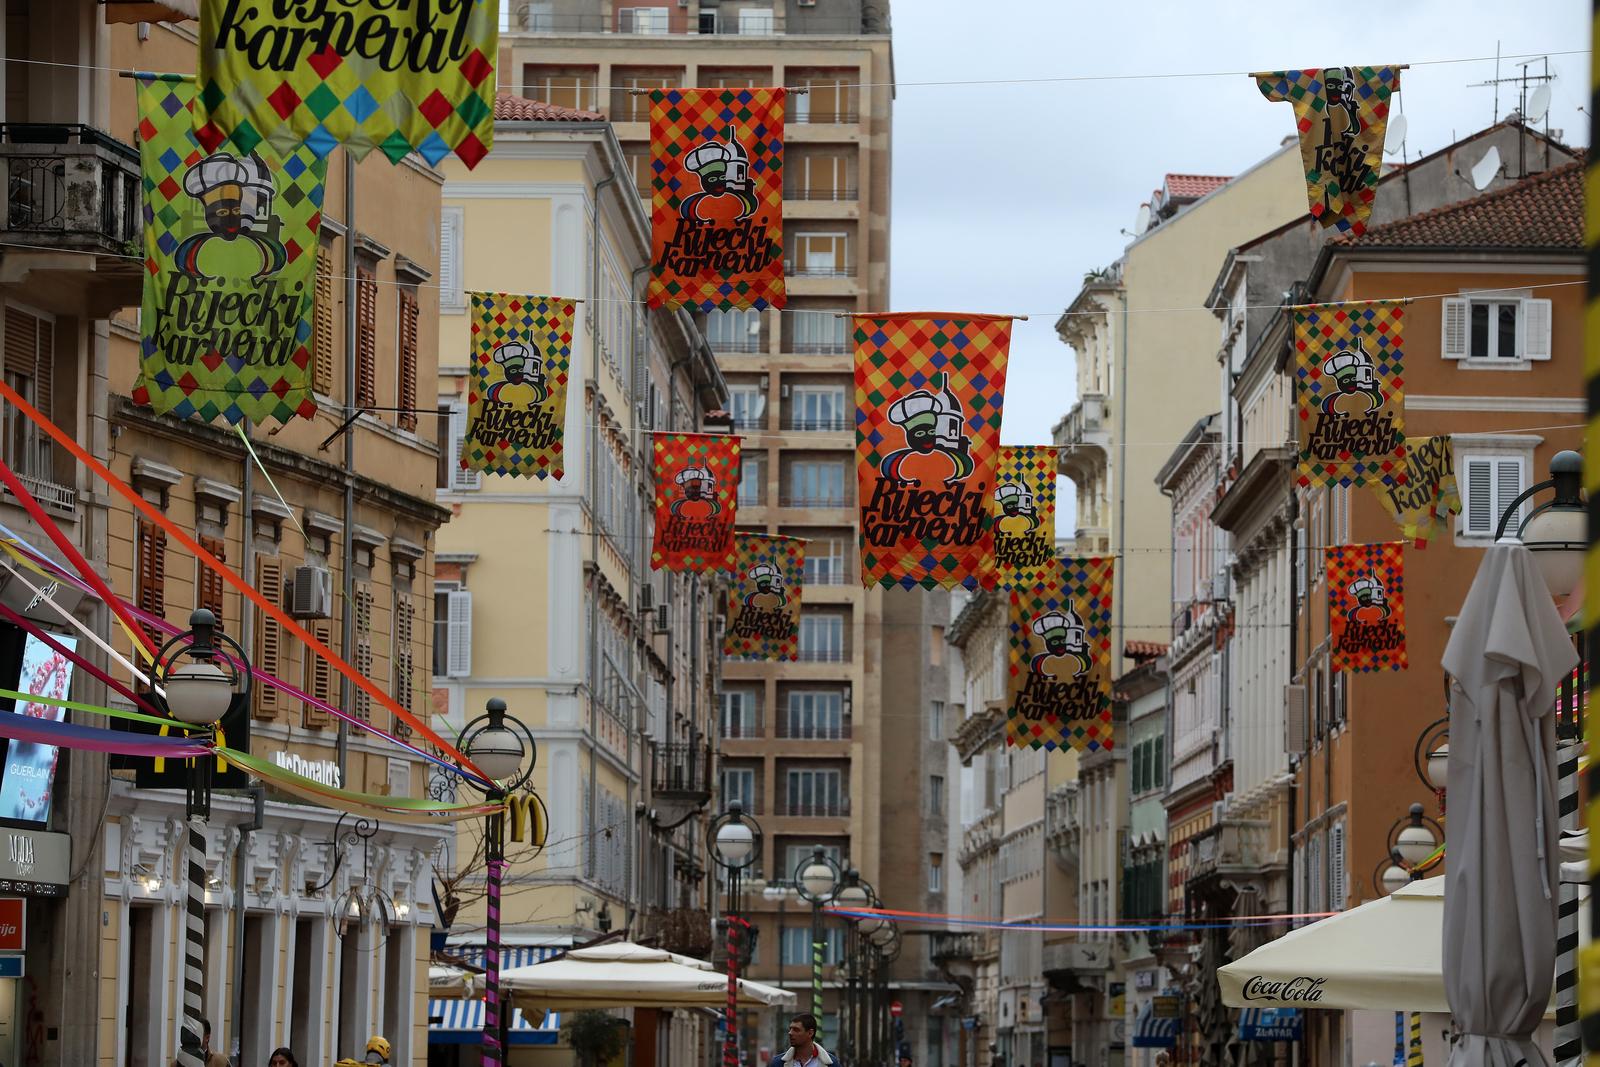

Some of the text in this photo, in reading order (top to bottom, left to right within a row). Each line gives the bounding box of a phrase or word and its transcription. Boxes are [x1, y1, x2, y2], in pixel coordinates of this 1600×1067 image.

[658, 239, 773, 277] karneval
[152, 308, 301, 367] karneval
[470, 418, 558, 449] karneval
[1307, 428, 1398, 459] karneval
[861, 506, 987, 547] karneval
[1014, 690, 1105, 720] karneval
[10, 763, 51, 779] GUERLAIN
